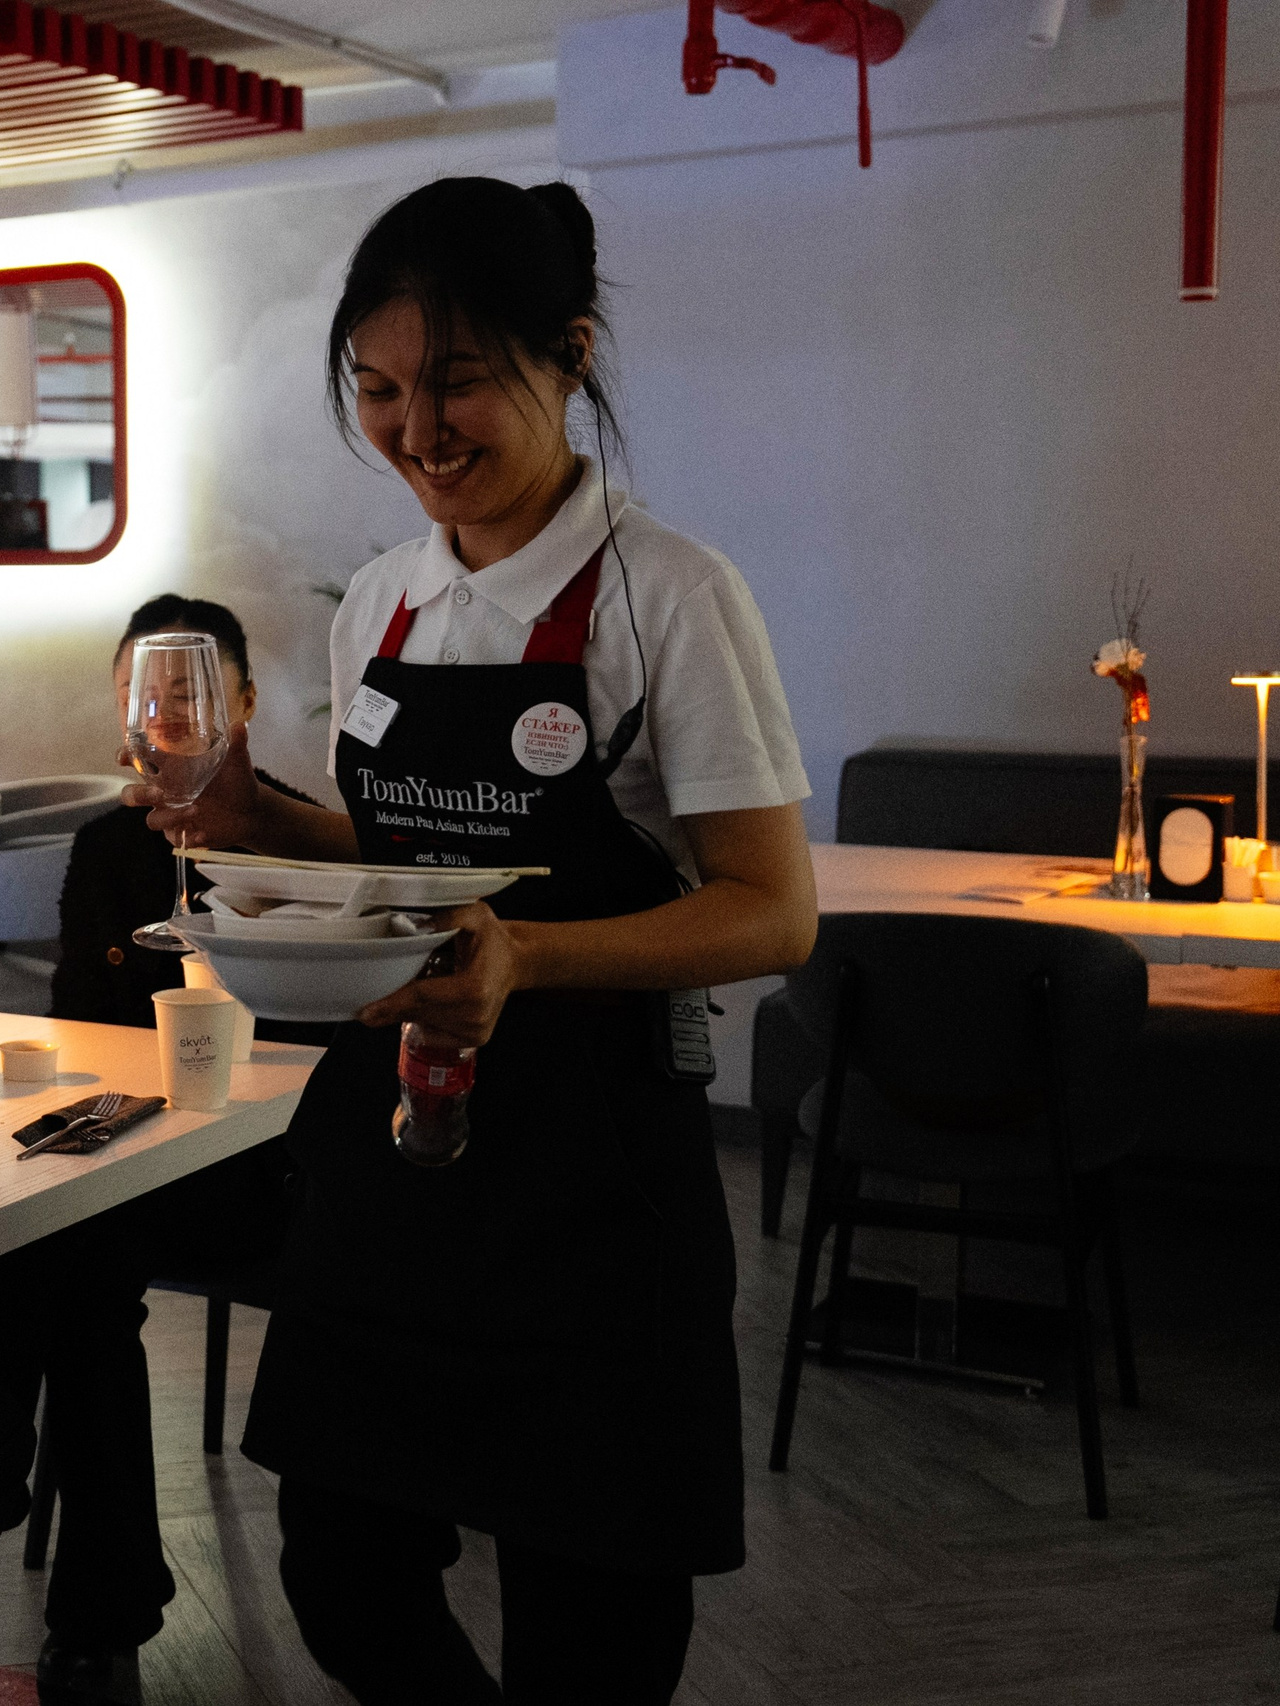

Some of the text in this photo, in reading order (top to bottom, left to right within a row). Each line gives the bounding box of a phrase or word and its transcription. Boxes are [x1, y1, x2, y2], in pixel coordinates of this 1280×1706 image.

[547, 707, 559, 718] Я
[521, 717, 581, 735] СТАЖЕР
[375, 810, 511, 837] Modern Pan Asian Kitchen
[415, 852, 471, 866] est. 2016
